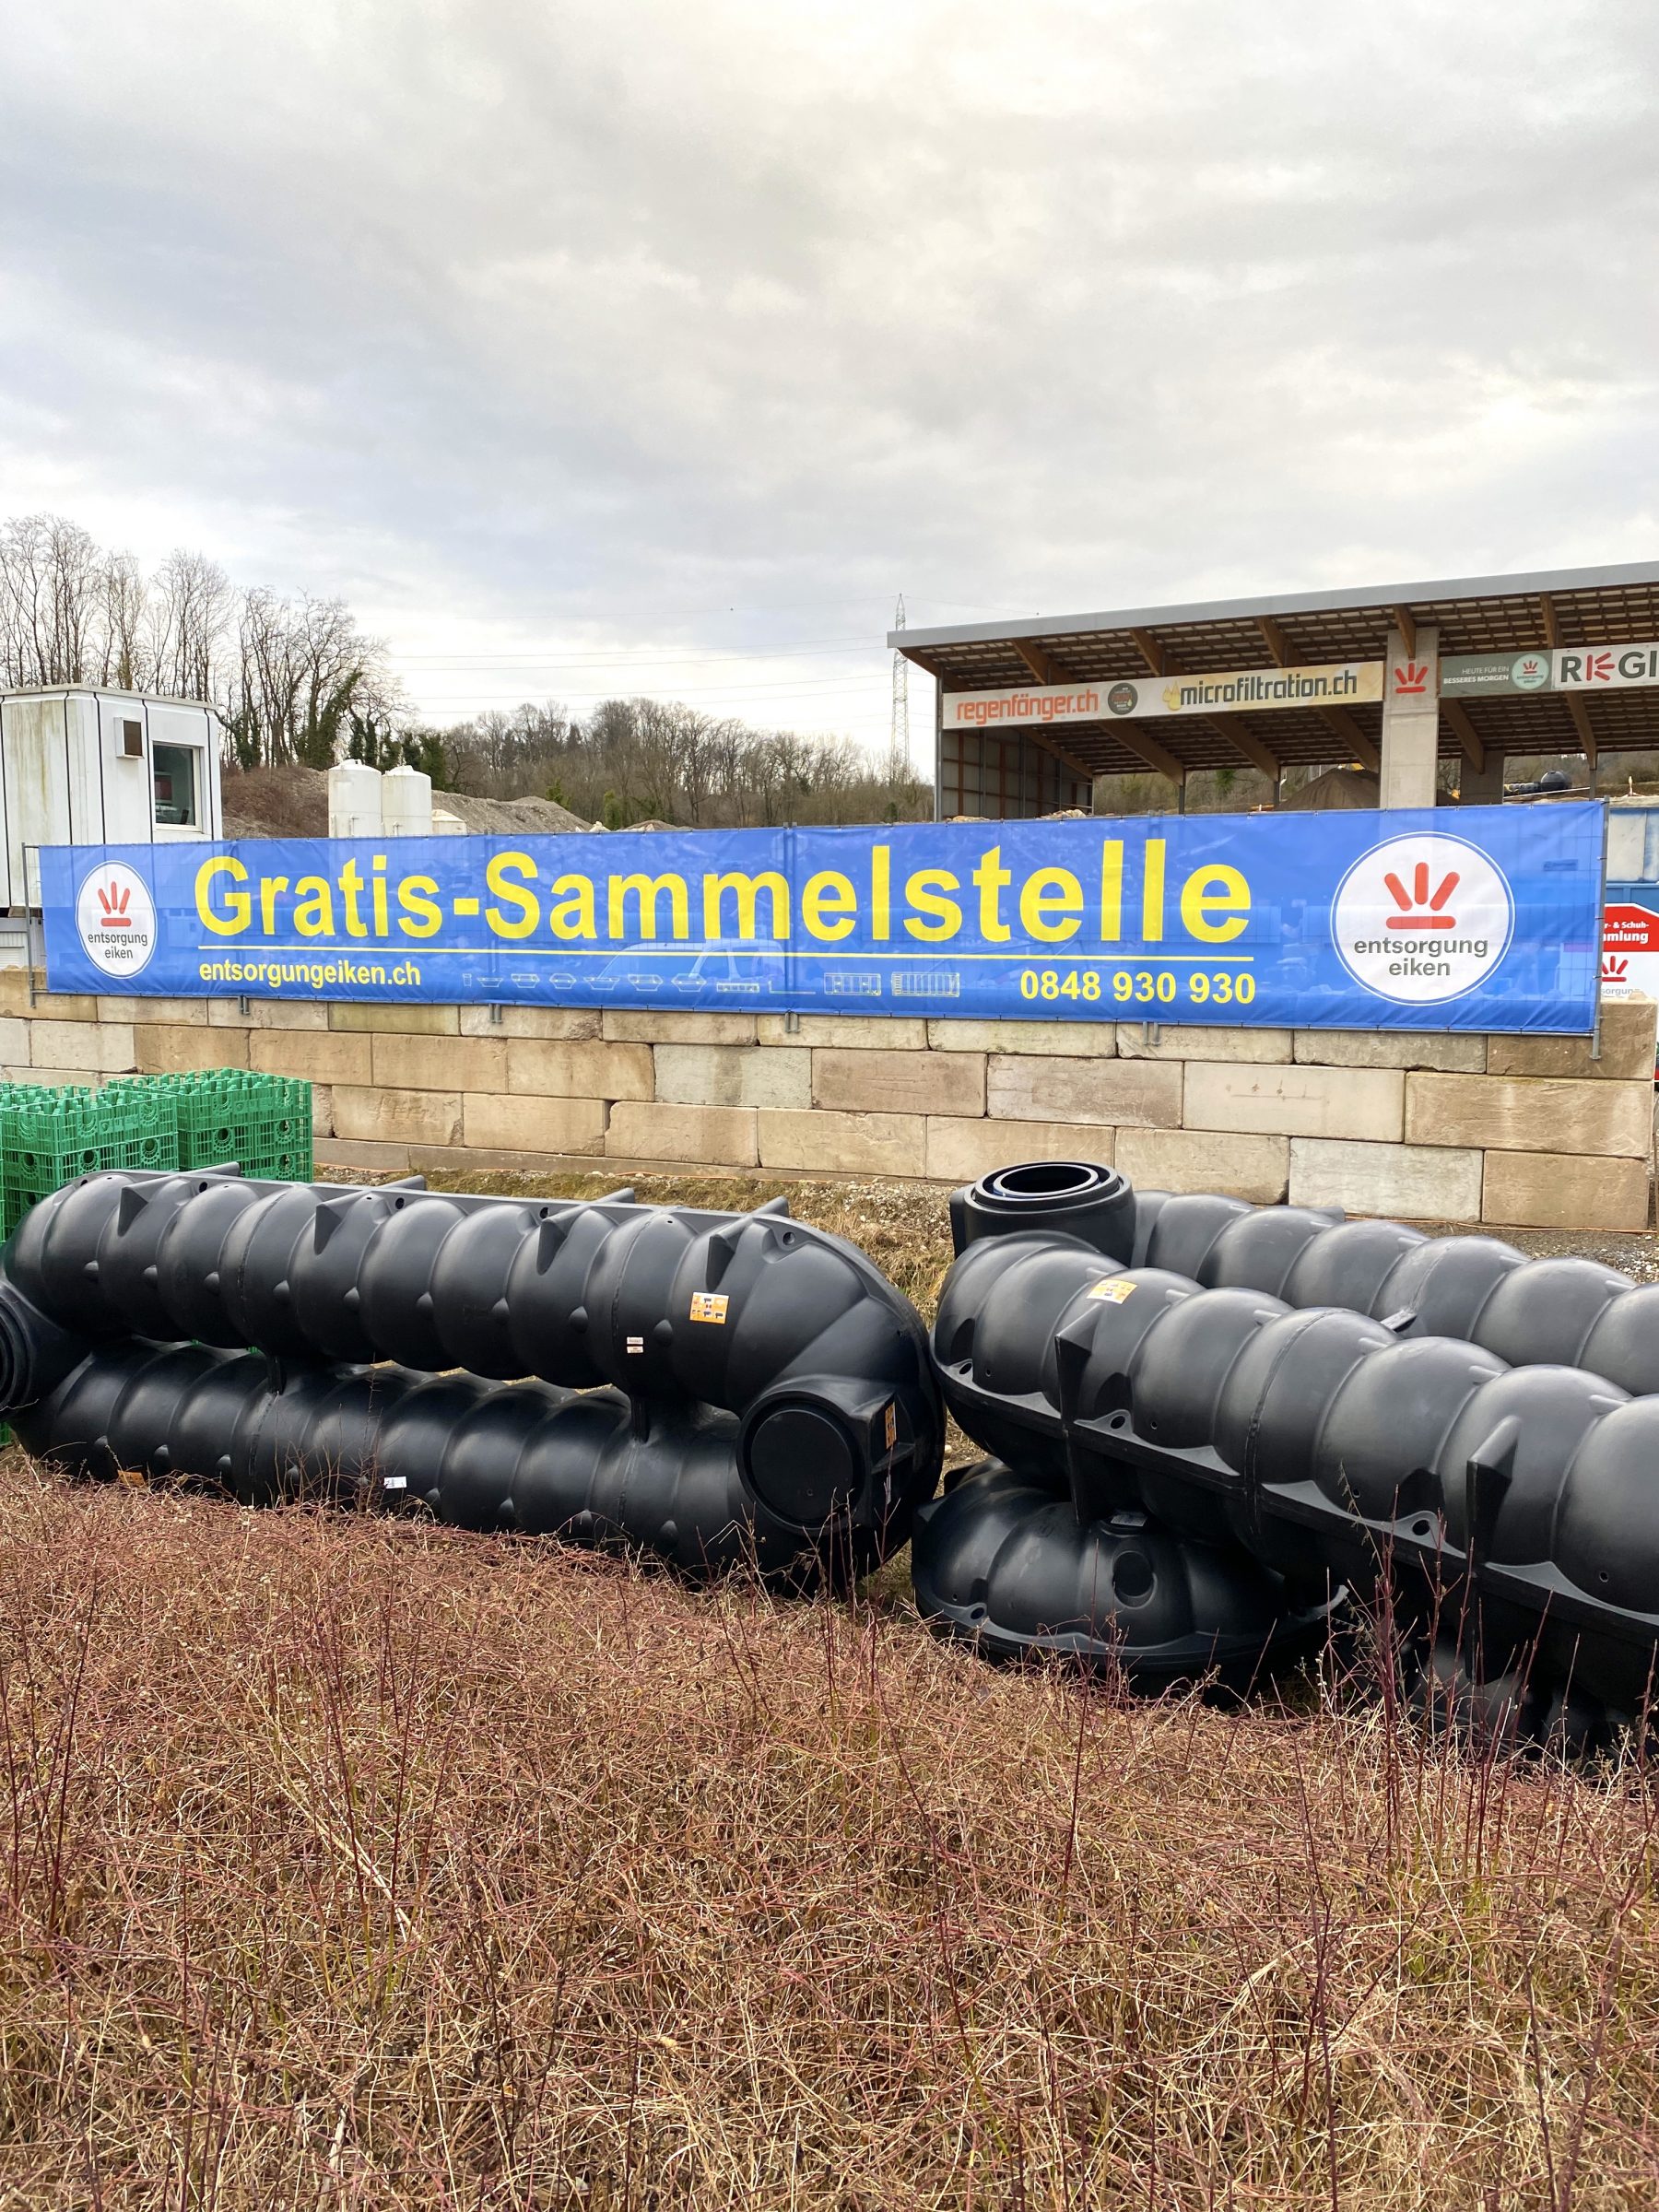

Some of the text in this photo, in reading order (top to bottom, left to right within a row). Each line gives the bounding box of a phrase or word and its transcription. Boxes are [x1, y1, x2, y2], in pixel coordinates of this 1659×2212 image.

[1443, 676, 1477, 685] BESSERES
[1477, 674, 1510, 683] MORGEN
[1484, 665, 1497, 674] FÜR
[1180, 669, 1358, 707] microfiltration.ch
[956, 688, 1100, 725] regenfänger.ch
[194, 839, 1252, 943] Gratis-Sammelstelle
[1613, 921, 1620, 929] &
[1621, 921, 1649, 929] Schuh-
[87, 932, 148, 947] entsorgung
[1353, 935, 1489, 959] entsorgung
[104, 946, 135, 960] eiken
[198, 959, 422, 989] entsorgungeiken.ch
[1388, 957, 1452, 978] eiken
[1020, 970, 1255, 1004] 0848 930 930
